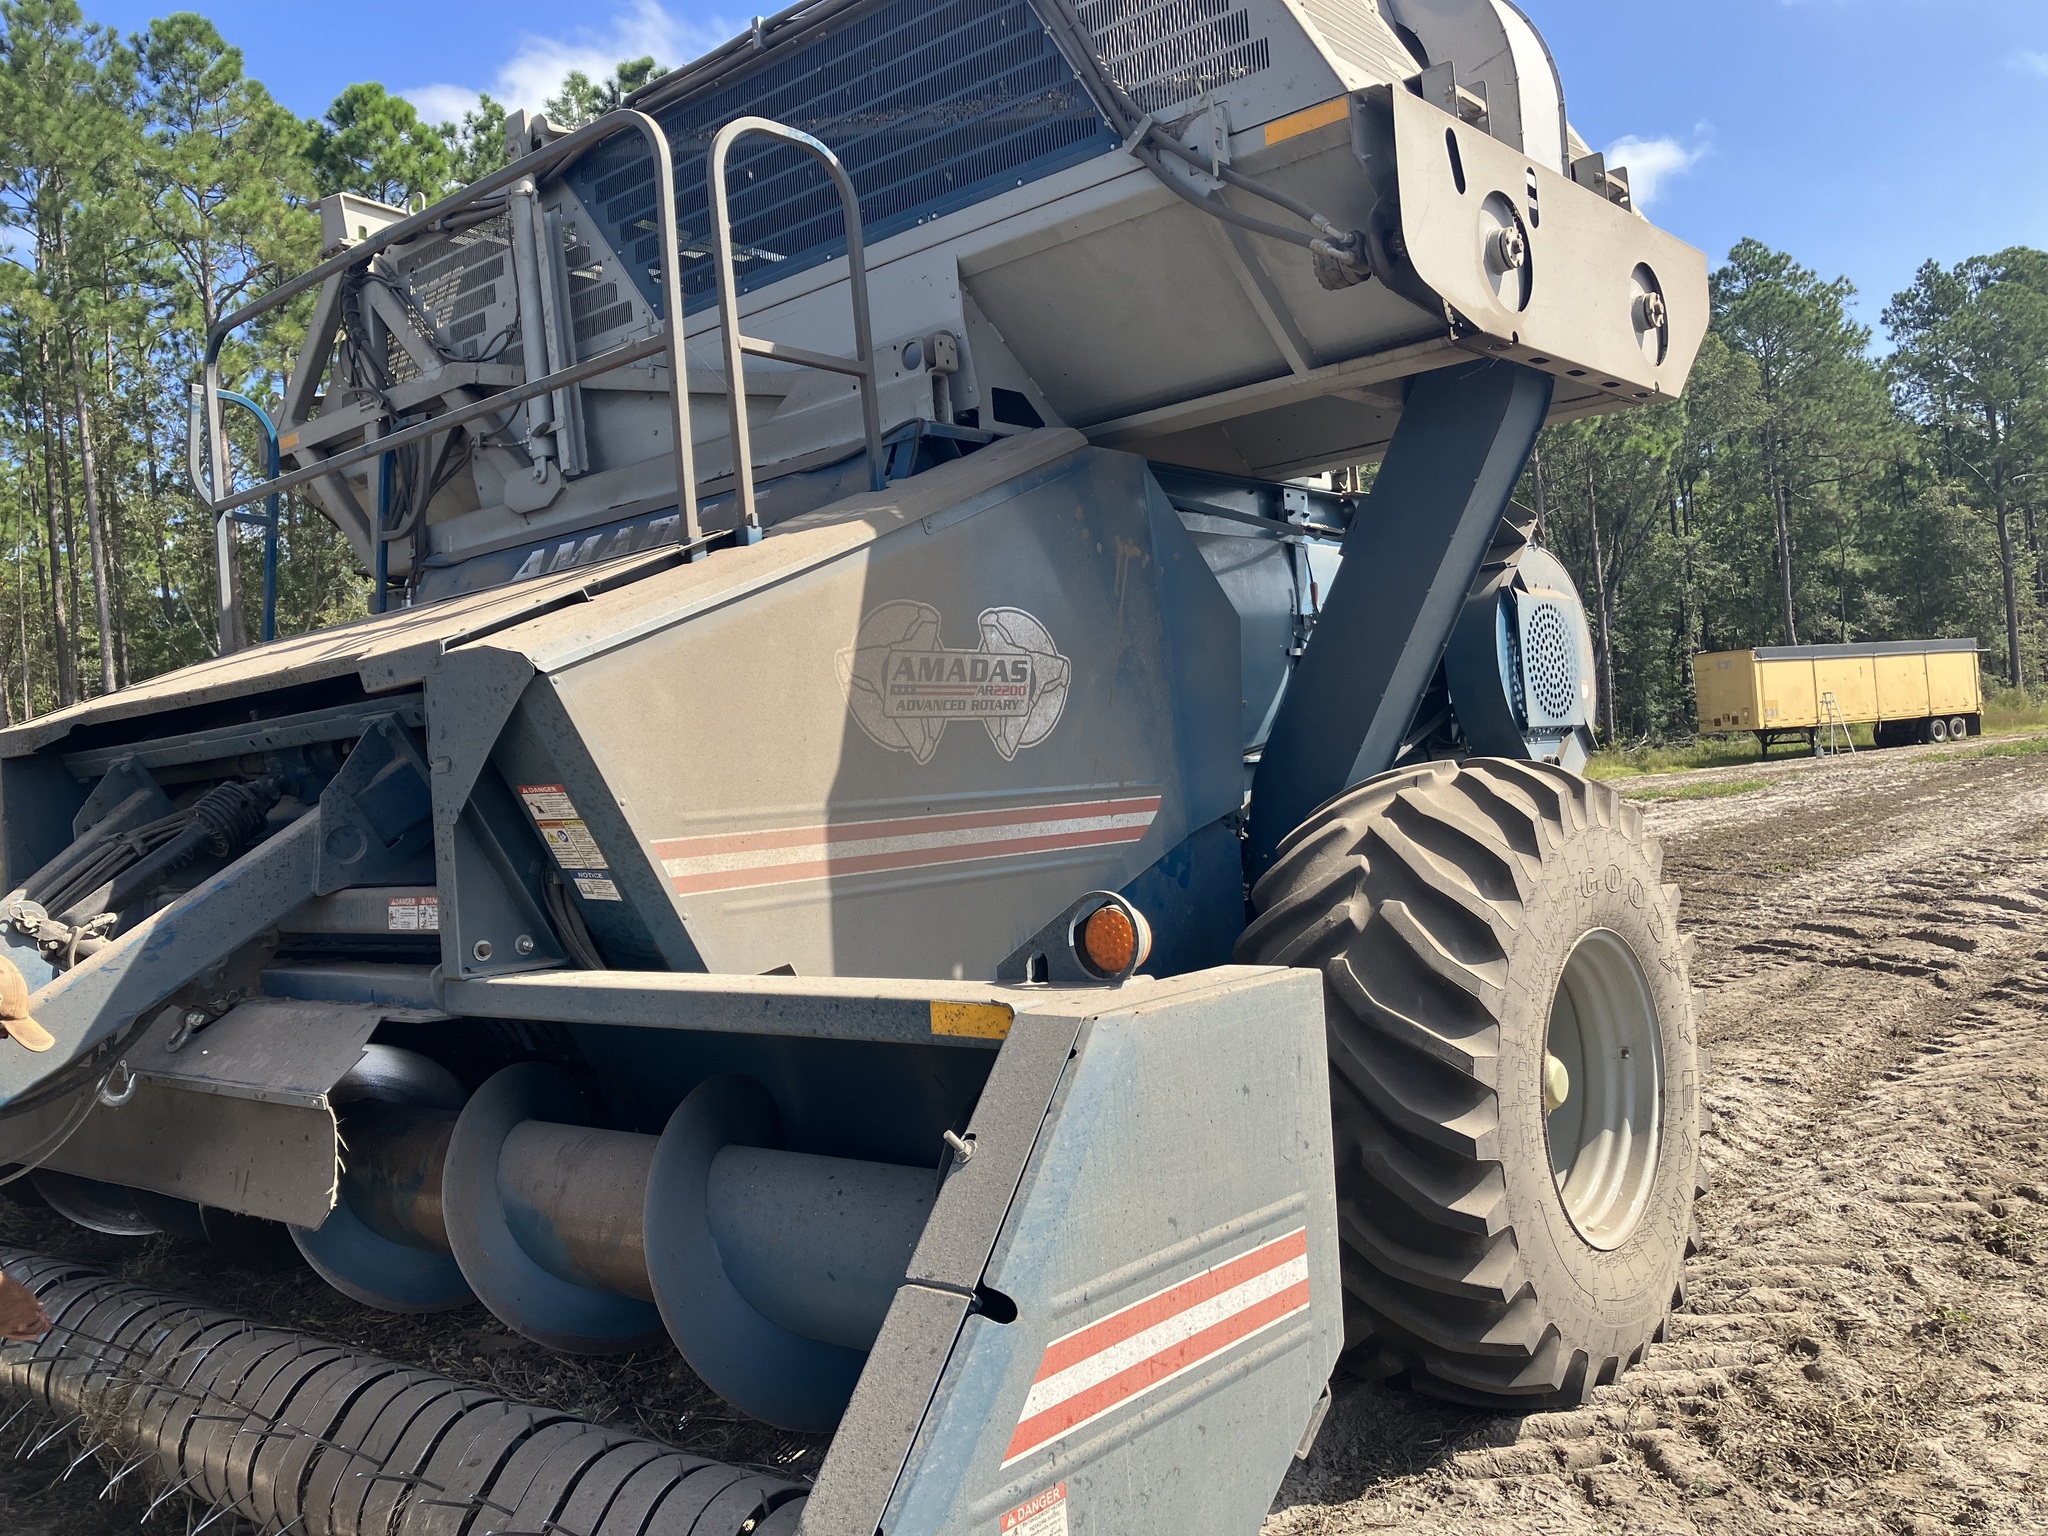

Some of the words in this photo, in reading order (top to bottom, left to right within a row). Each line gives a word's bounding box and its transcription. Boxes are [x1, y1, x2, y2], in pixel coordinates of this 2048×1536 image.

[892, 656, 1028, 683] AMADAS
[976, 684, 1027, 697] AR2200
[895, 699, 966, 711] ADVANCED
[970, 699, 1020, 711] ROTARY
[577, 871, 603, 879] NOTICE
[396, 897, 416, 906] DANGER
[1017, 1487, 1061, 1521] DANGER
